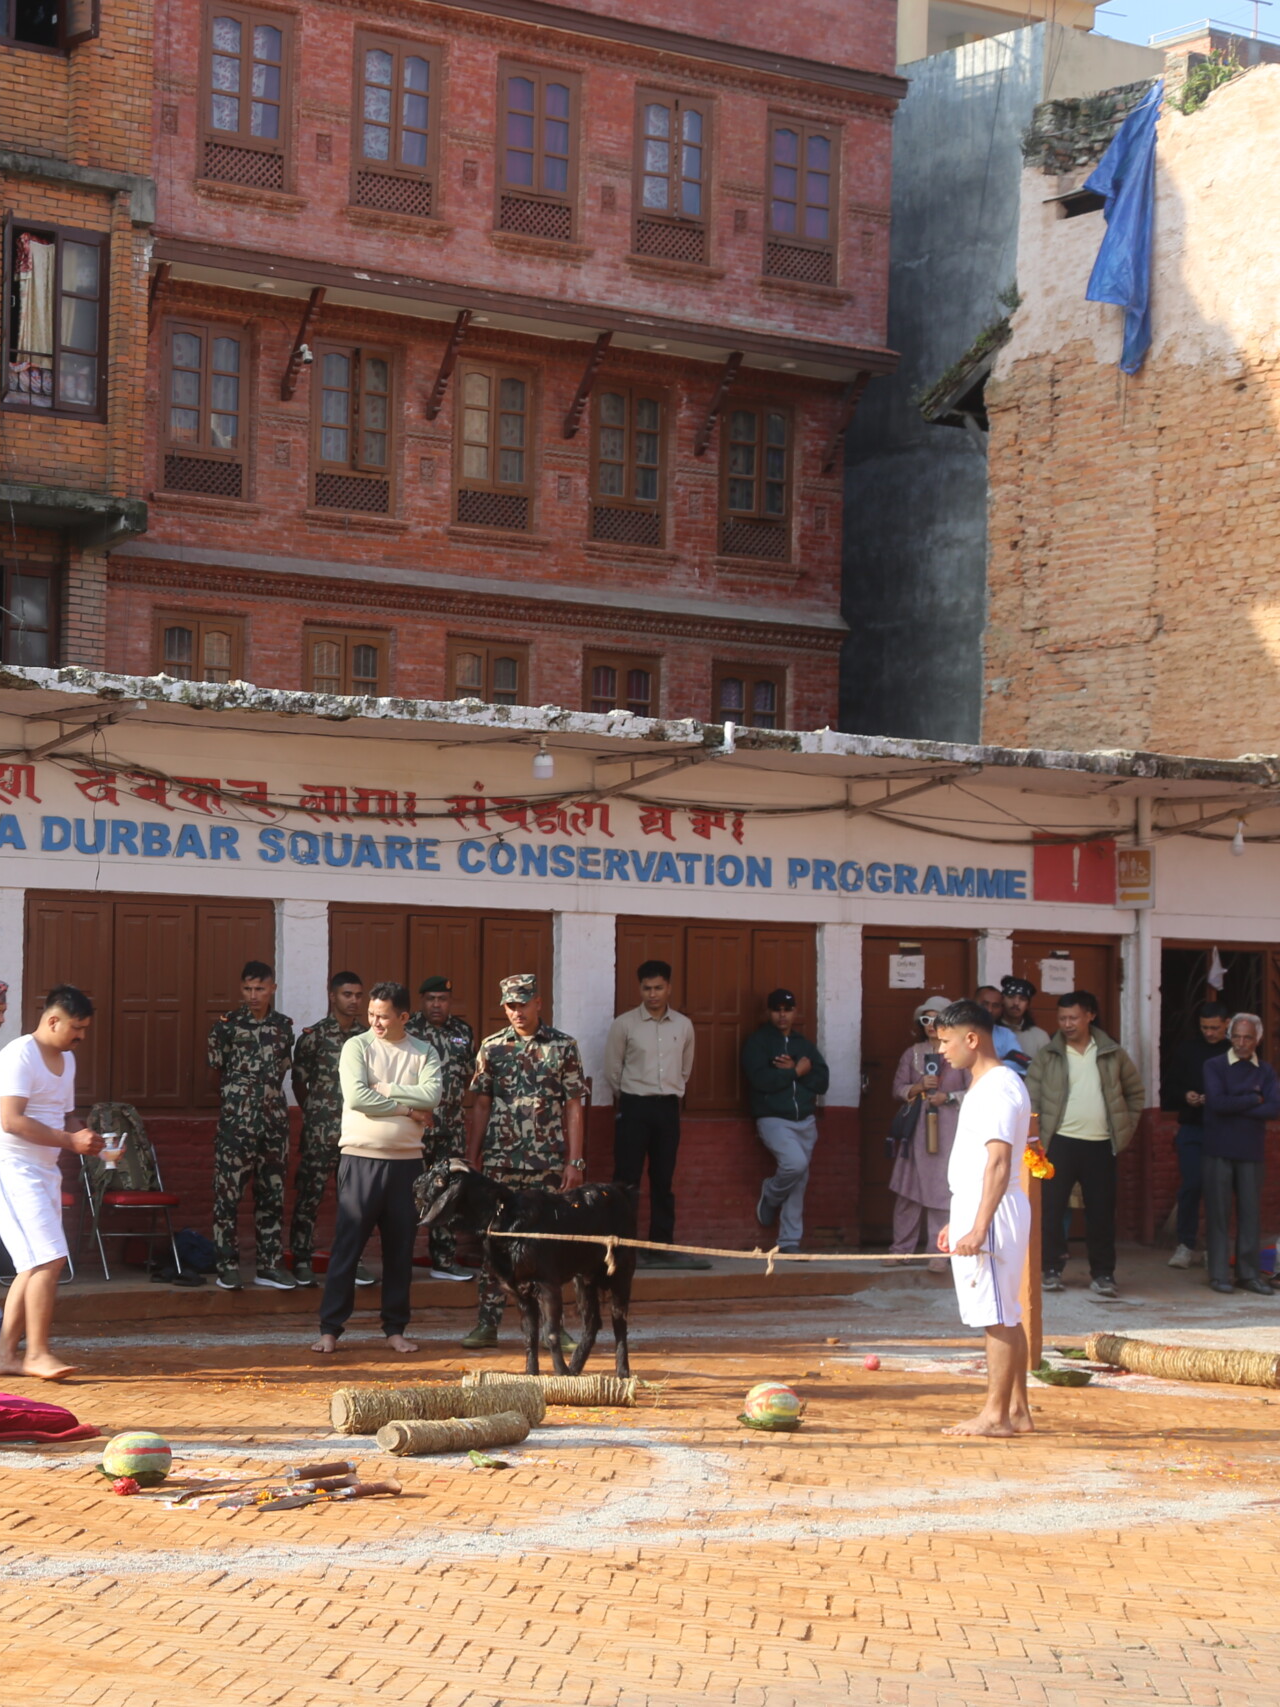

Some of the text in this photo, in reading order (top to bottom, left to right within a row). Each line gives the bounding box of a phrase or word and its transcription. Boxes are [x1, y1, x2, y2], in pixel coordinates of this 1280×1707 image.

[41, 816, 240, 860] DURBAR
[259, 829, 441, 871] SQUARE
[458, 841, 773, 888] CONSERVATION
[788, 858, 1027, 900] PROGRAMME
